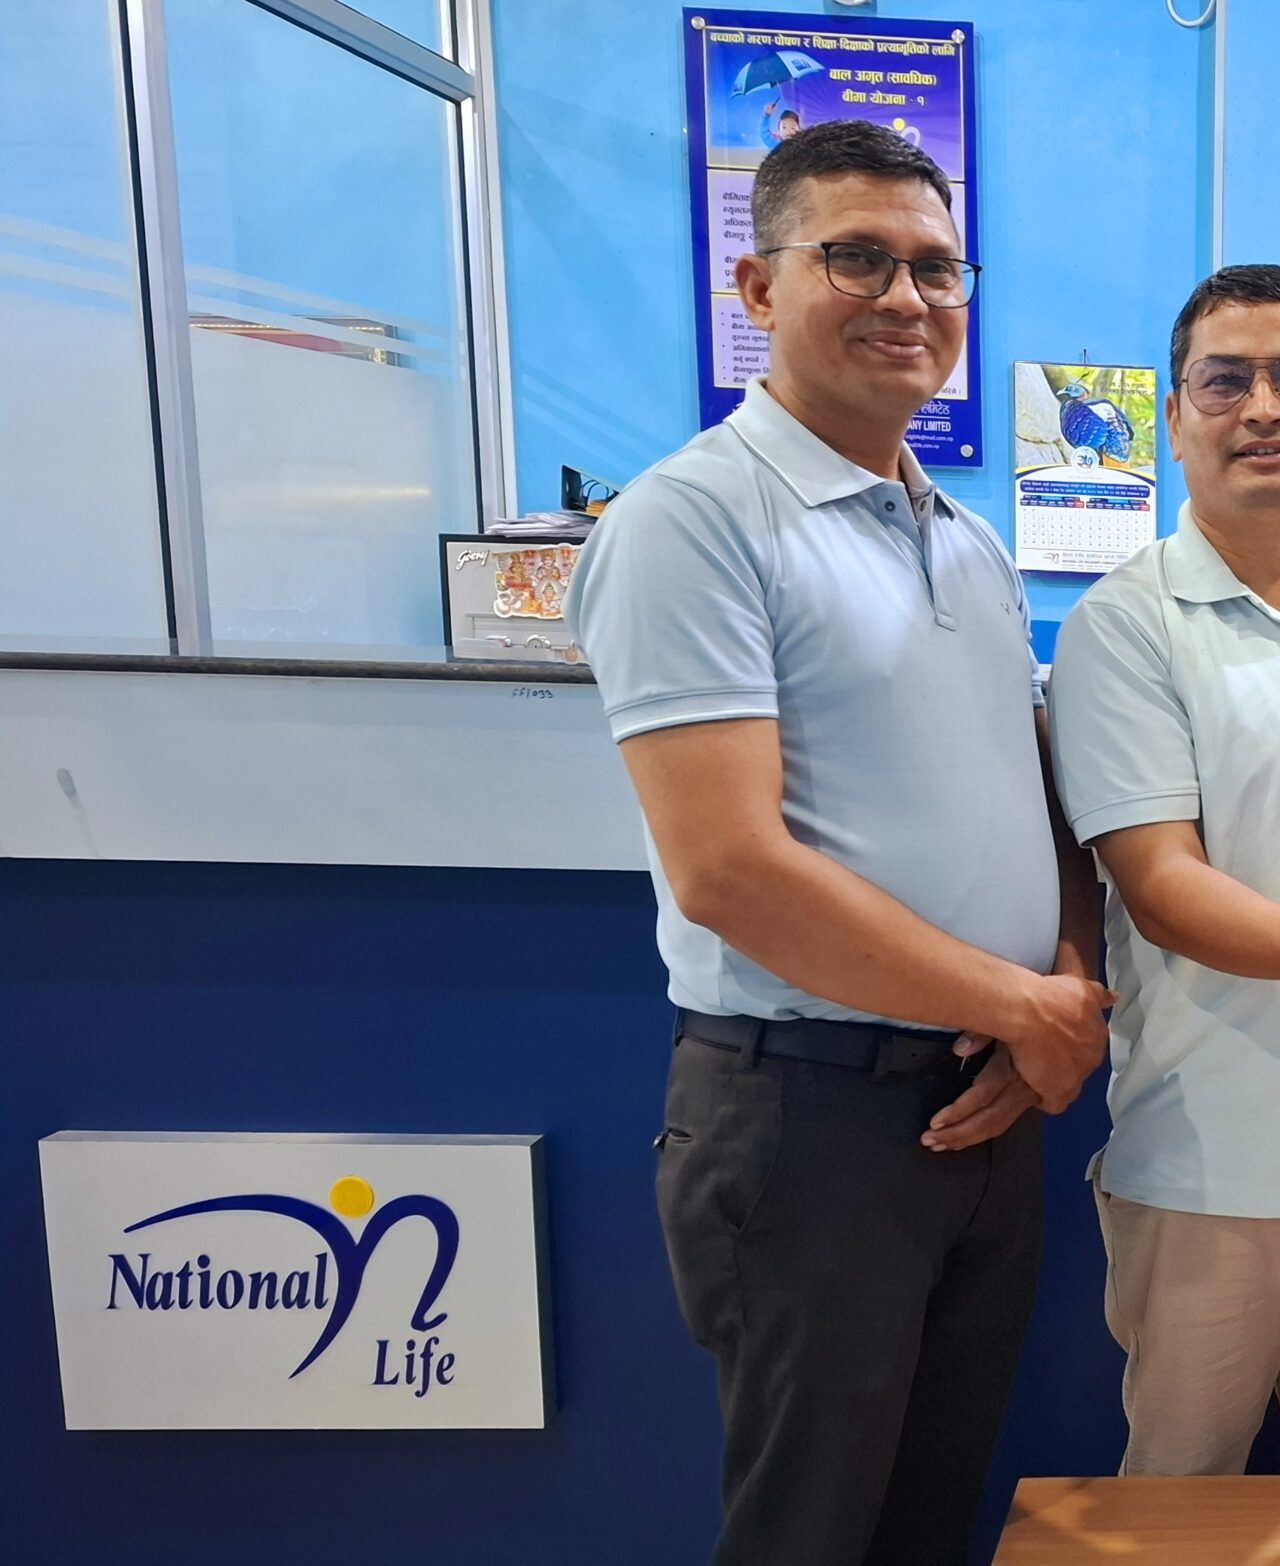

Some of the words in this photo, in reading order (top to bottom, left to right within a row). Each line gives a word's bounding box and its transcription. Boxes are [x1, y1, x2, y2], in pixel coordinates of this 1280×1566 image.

[870, 91, 905, 105] योजना
[907, 419, 922, 431] ANY
[923, 420, 952, 432] LIMITED
[105, 1251, 330, 1312] National
[372, 1335, 456, 1398] Life
